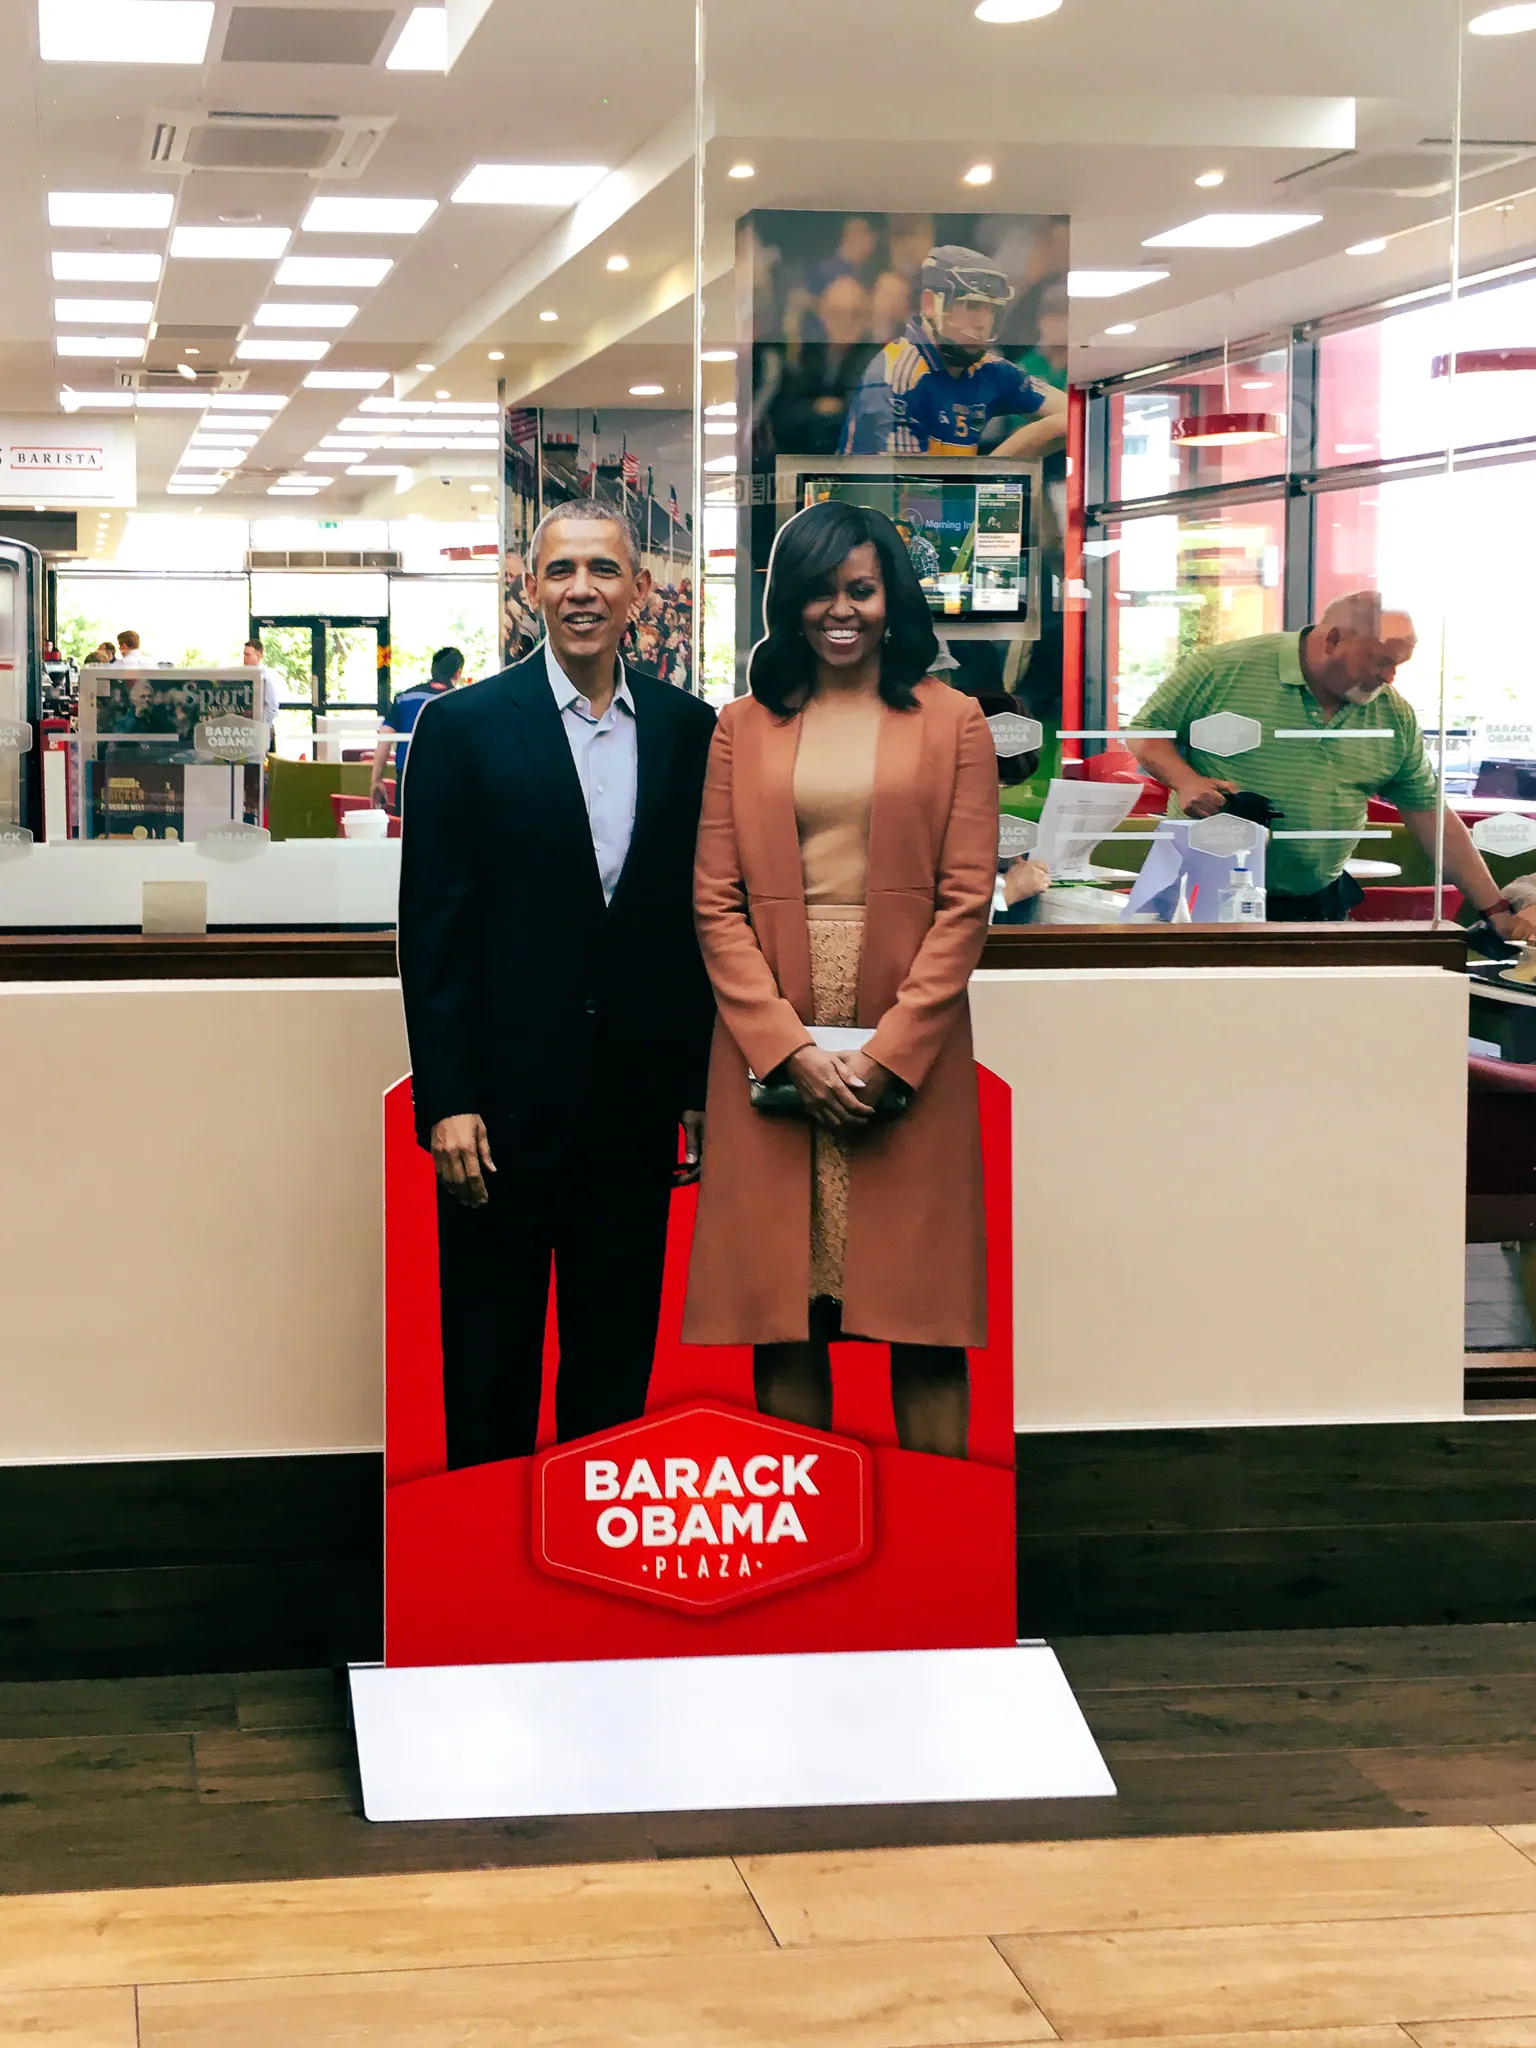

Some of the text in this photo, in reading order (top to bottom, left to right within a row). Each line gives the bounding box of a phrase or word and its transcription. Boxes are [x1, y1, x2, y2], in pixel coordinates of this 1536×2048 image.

[18, 453, 97, 465] BARISTA
[925, 519, 962, 532] Morning
[182, 682, 252, 712] Sport
[205, 726, 257, 737] BARACK
[989, 723, 1032, 733] ARACK
[1485, 723, 1534, 734] BARACK
[208, 736, 255, 748] OBAMA
[994, 733, 1029, 744] BAMA
[1488, 733, 1531, 743] OBAMA
[584, 1453, 820, 1501] BARACK
[596, 1501, 808, 1549] OBAMA
[655, 1552, 751, 1580] PLAZA
